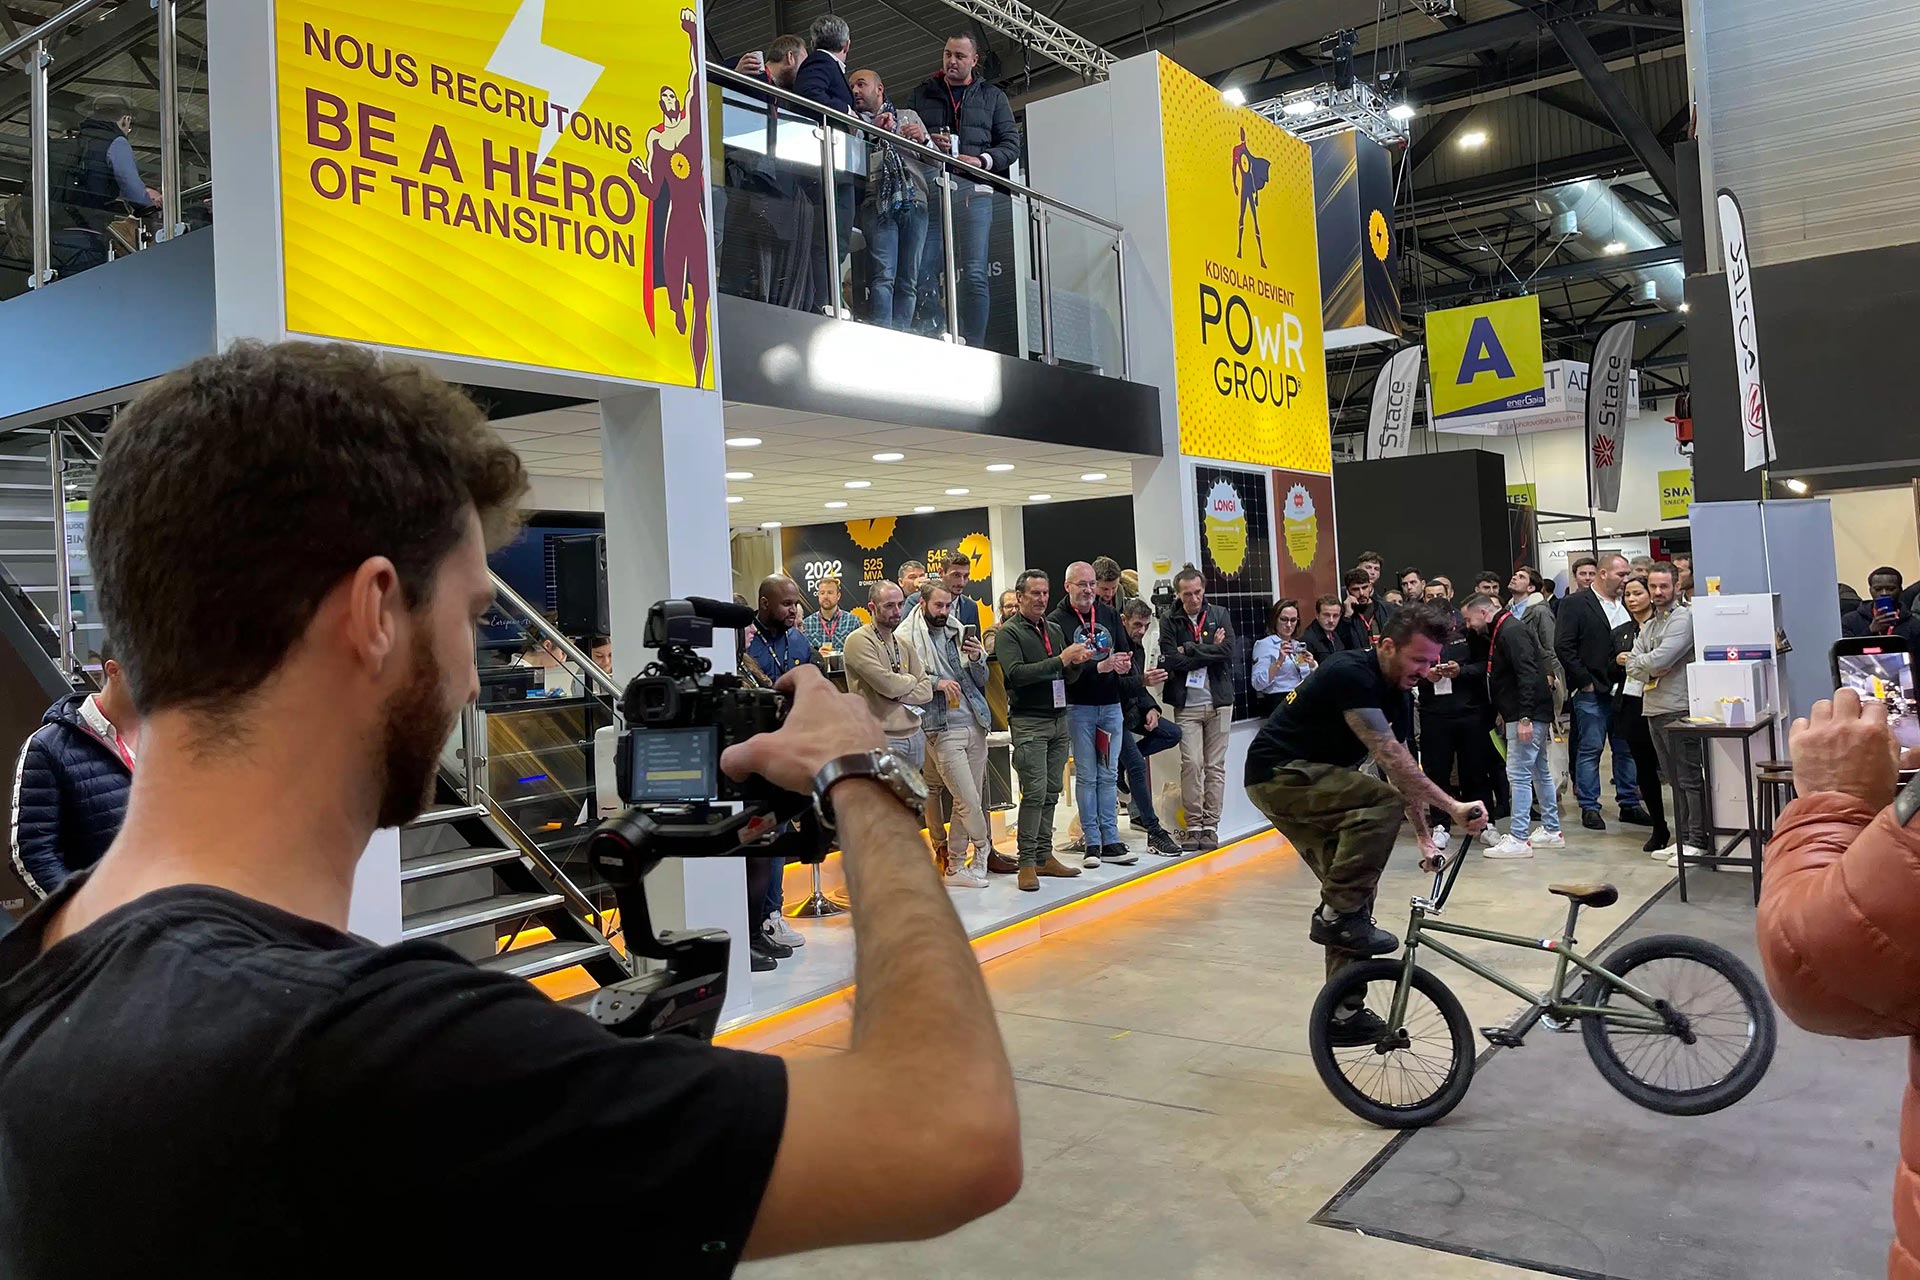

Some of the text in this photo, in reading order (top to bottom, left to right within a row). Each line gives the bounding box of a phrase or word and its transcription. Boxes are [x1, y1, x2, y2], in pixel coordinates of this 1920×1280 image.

[304, 22, 632, 154] NOUS RECRUTONS
[305, 87, 636, 225] BE A HERO
[309, 157, 635, 267] OF TRANSITION
[1205, 259, 1295, 307] KDISOLAR DEVIENT
[1199, 282, 1306, 373] POwR
[1456, 316, 1515, 385] A
[1379, 381, 1405, 448] Stace
[1598, 355, 1621, 427] Stace
[1506, 493, 1528, 504] TES
[1663, 487, 1693, 498] SNA
[804, 560, 843, 580] 2022
[863, 557, 884, 571] 525
[864, 570, 884, 581] MVA
